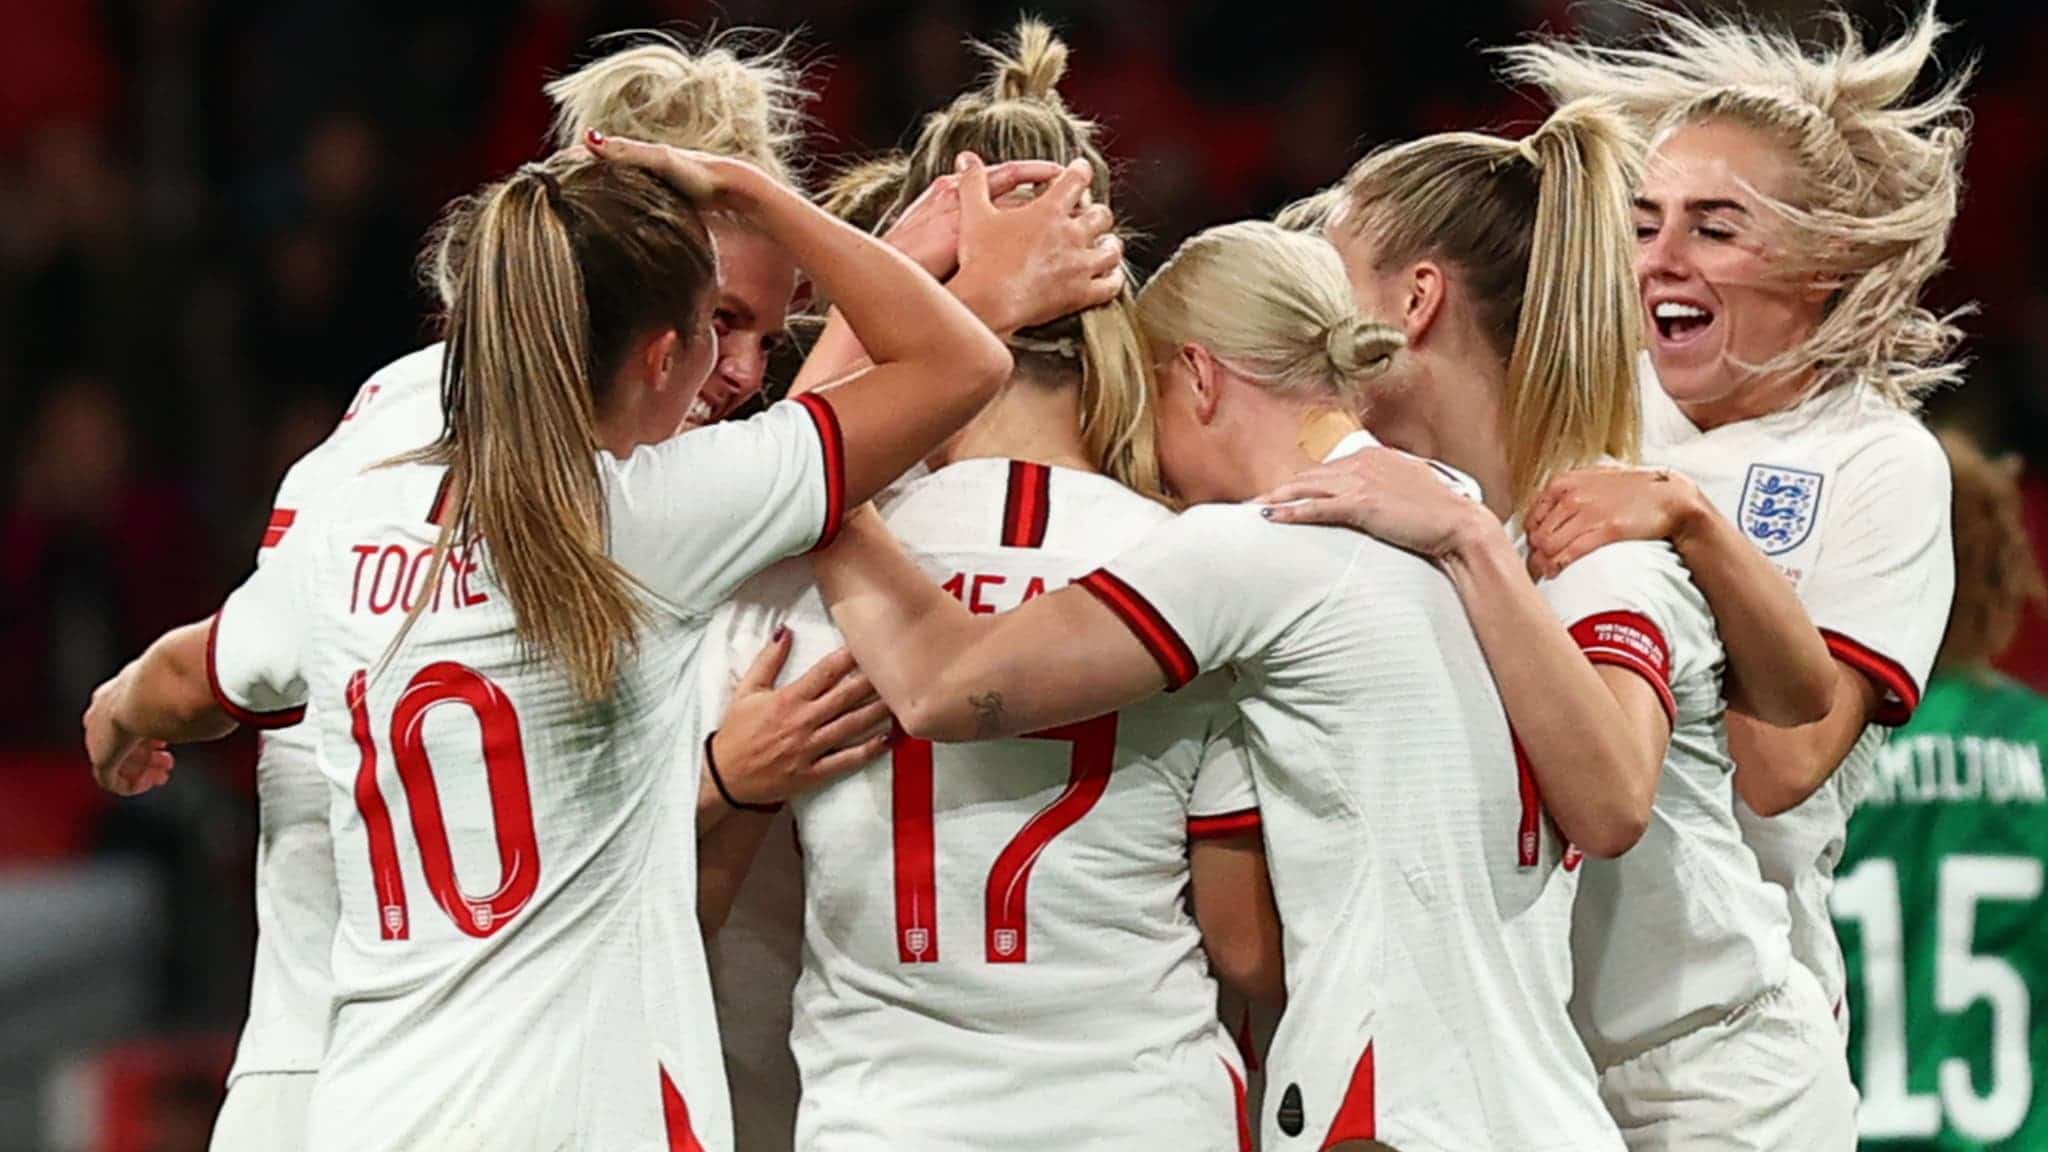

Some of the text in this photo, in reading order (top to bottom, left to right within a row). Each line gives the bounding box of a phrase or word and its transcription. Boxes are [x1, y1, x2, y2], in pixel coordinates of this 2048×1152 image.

[345, 660, 541, 940] 10
[891, 710, 1118, 963] 17
[1828, 853, 2044, 1142] 15
